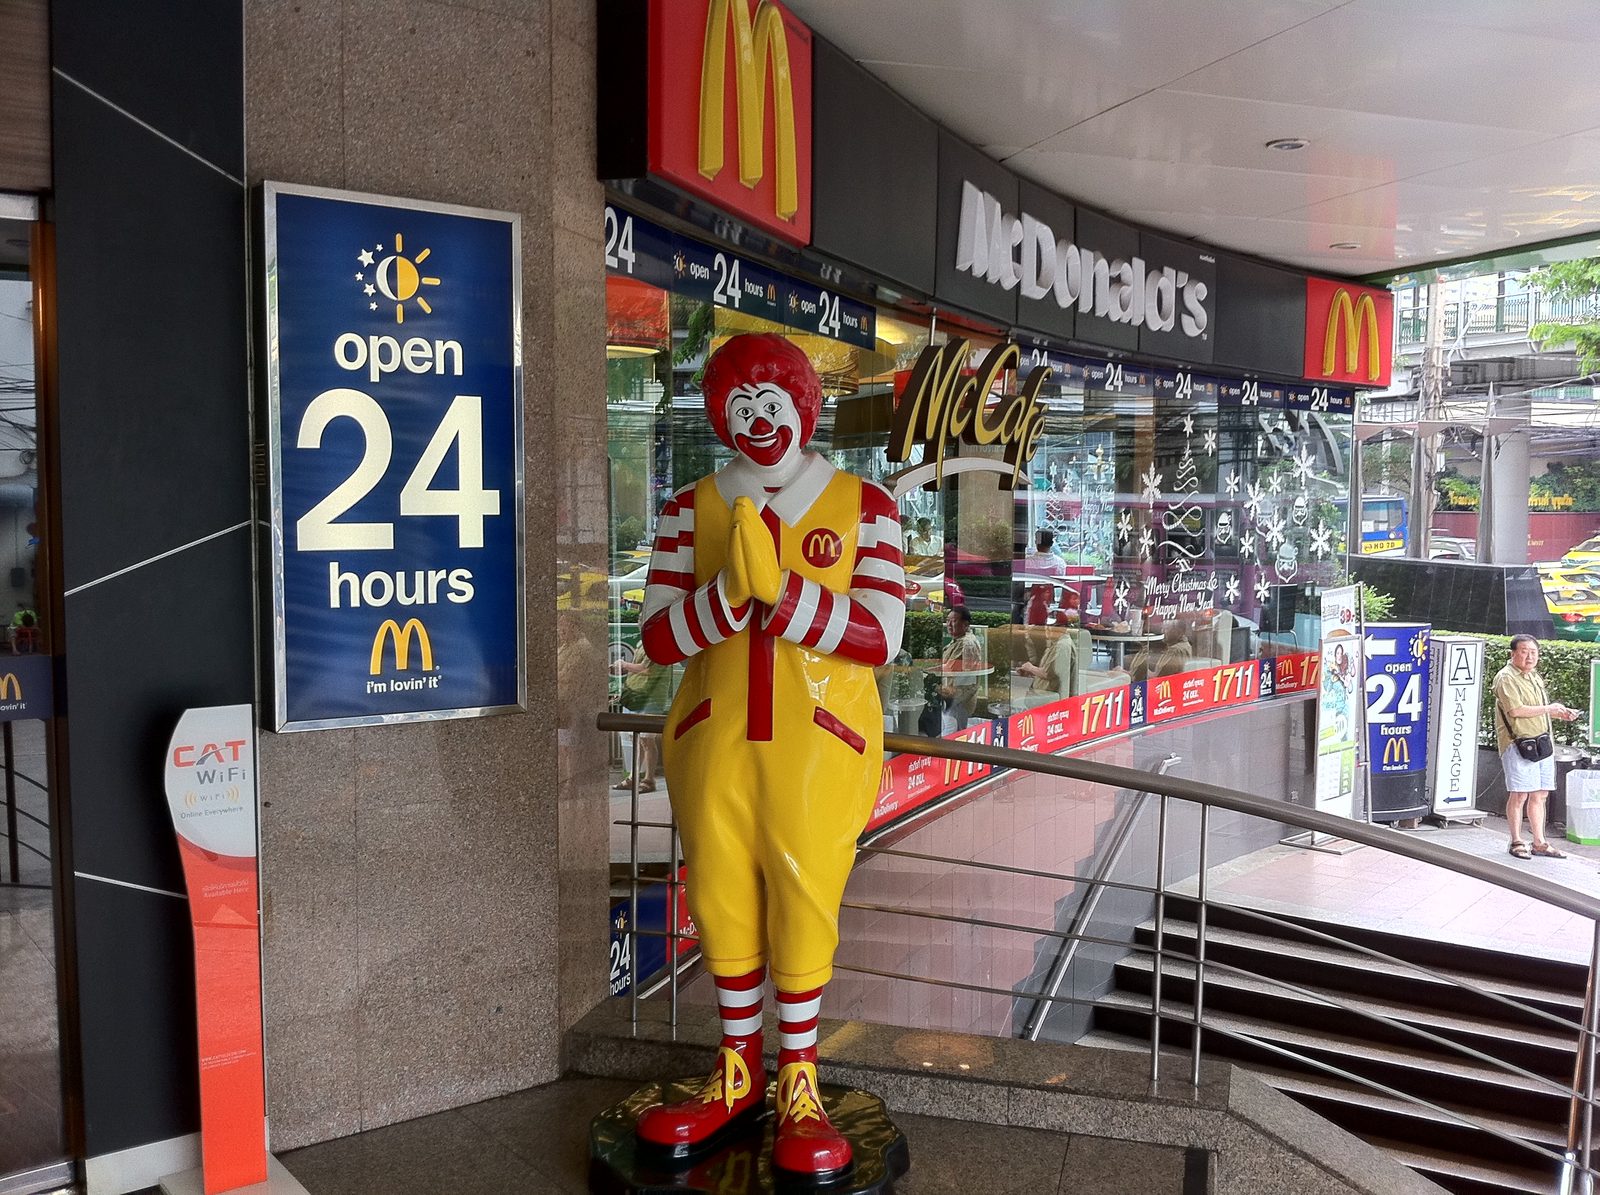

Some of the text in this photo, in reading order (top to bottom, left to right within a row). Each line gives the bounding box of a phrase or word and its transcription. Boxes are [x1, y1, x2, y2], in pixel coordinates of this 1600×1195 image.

[605, 206, 635, 274] 24
[955, 179, 1208, 338] McDonald's
[690, 252, 763, 308] open 24 hours
[801, 291, 857, 338] open 24 hours
[334, 332, 463, 382] open
[1091, 370, 1104, 380] open
[1105, 363, 1123, 392] 24
[1175, 372, 1192, 399] 24
[1241, 380, 1259, 405] 24
[1310, 387, 1329, 412] 24
[297, 388, 500, 551] 24
[330, 561, 475, 608] hours
[1144, 576, 1170, 598] Merry
[1172, 572, 1206, 593] Christmas
[1148, 592, 1213, 619] Happy New Year
[1300, 656, 1319, 688] 17
[1385, 662, 1412, 674] open
[1451, 647, 1472, 681] A
[366, 676, 439, 694] i'm lovin' it
[1212, 664, 1254, 702] 1711
[1260, 671, 1272, 689] 24
[1131, 697, 1143, 717] 24
[1365, 673, 1423, 723] 24
[1081, 690, 1124, 735] 1711
[1381, 724, 1412, 736] hours
[1449, 688, 1466, 792] MASSAGE
[174, 740, 246, 768] CAT
[197, 767, 246, 785] WiFi
[181, 806, 243, 819] Online Everywhere
[874, 800, 899, 819] McDelivery
[610, 932, 631, 981] 24
[610, 972, 631, 997] hours
